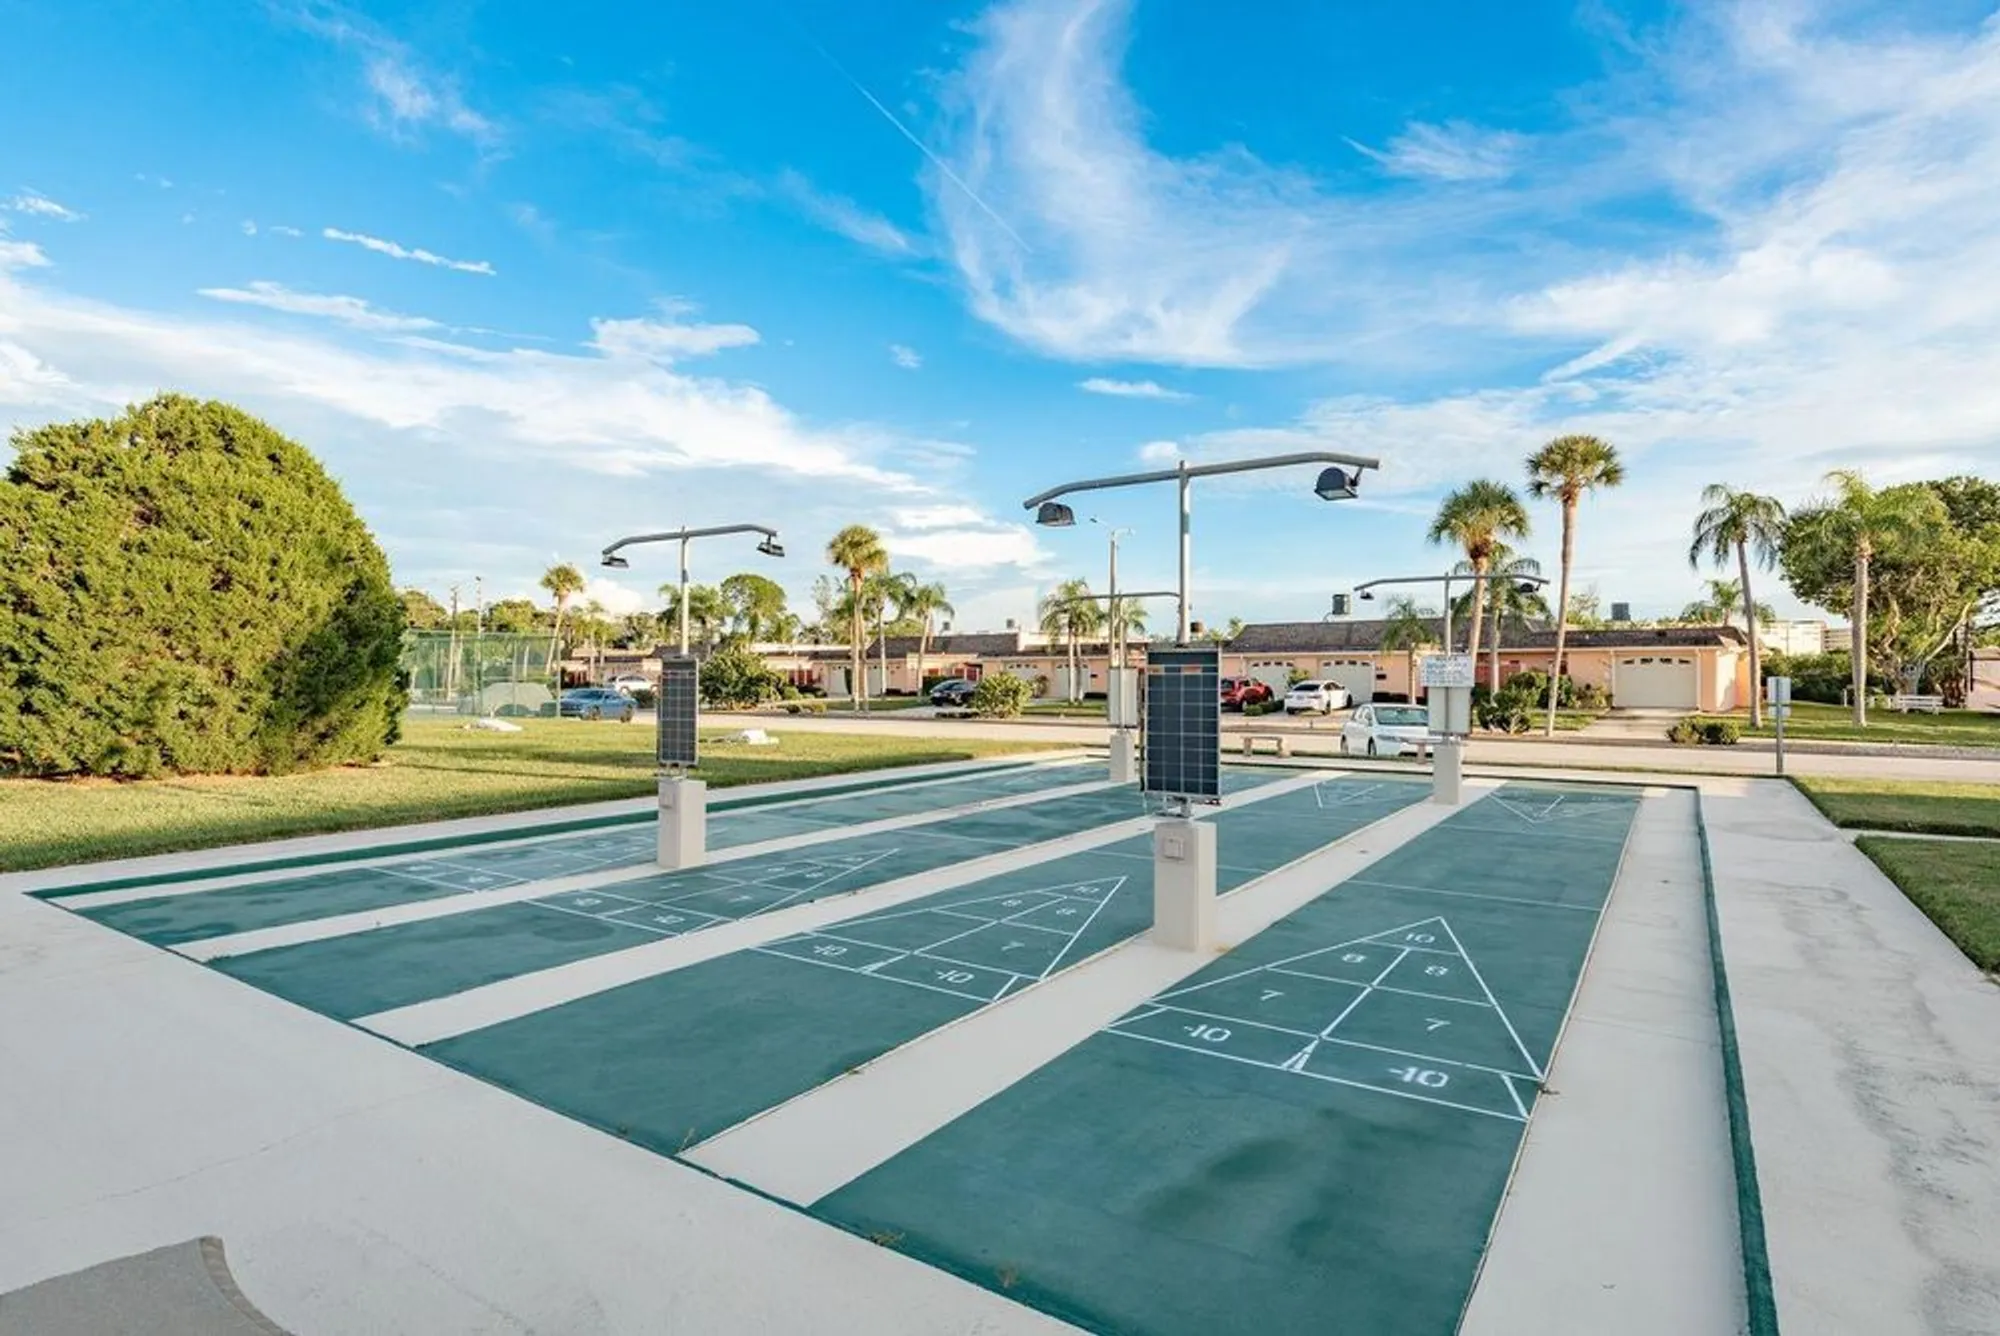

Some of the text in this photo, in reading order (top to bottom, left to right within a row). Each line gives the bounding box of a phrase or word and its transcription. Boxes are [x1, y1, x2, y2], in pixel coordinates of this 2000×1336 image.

[1406, 933, 1435, 943] 10
[1260, 989, 1285, 1001] 7
[1425, 1018, 1451, 1031] 7
[1183, 1023, 1232, 1042] -10
[1388, 1066, 1449, 1088] -10
